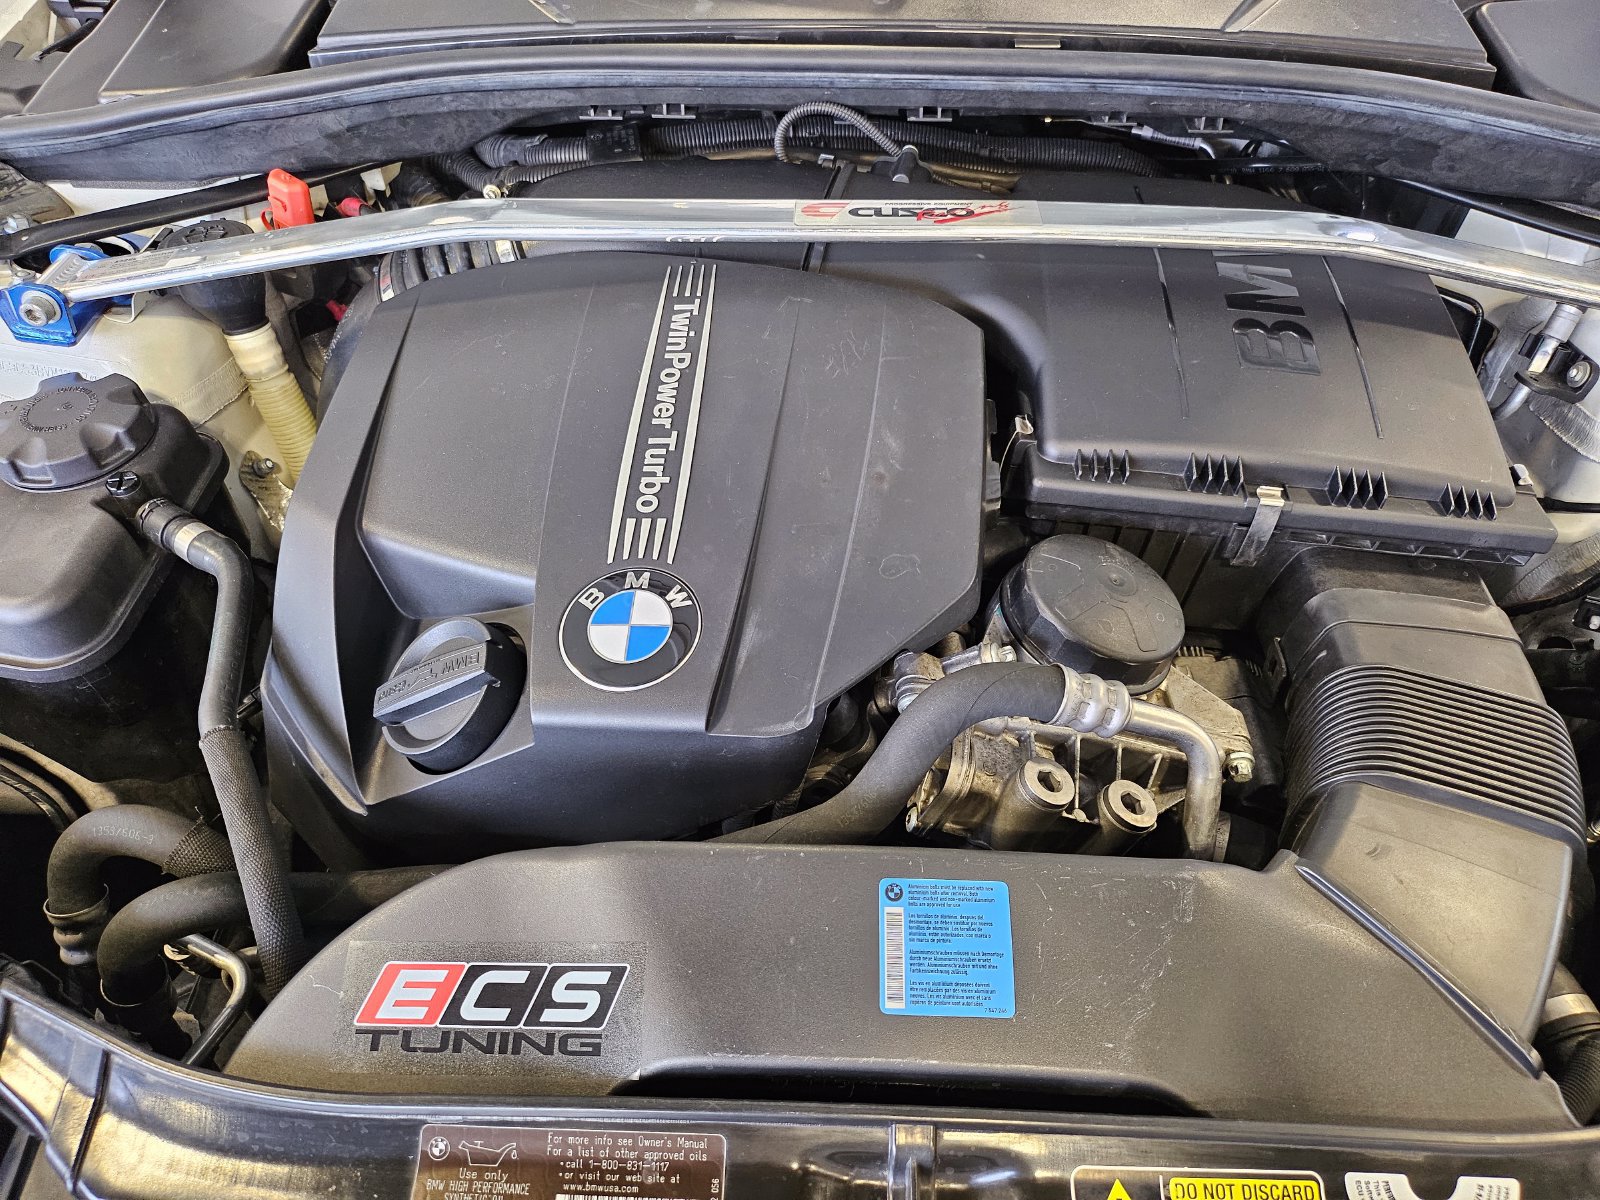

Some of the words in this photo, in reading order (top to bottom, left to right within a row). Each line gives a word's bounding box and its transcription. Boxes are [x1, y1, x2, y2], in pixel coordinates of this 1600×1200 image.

[1211, 251, 1320, 376] BM
[636, 431, 678, 514] Turbo
[578, 572, 693, 610] BMW
[375, 969, 612, 1022] ECS
[355, 1029, 602, 1056] TUNING
[547, 1132, 562, 1144] For
[568, 1135, 589, 1144] more
[595, 1134, 612, 1145] info
[618, 1137, 632, 1146] see
[639, 1136, 672, 1147] Owner's
[677, 1137, 708, 1149] Manual
[547, 1145, 562, 1156] For
[578, 1146, 594, 1157] list
[600, 1147, 609, 1158] of
[615, 1148, 638, 1159] other
[644, 1149, 684, 1161] approved
[689, 1150, 707, 1161] oils
[566, 1160, 583, 1168] call
[589, 1160, 669, 1172] 1-800-831-1117
[460, 1168, 477, 1179] Use
[485, 1170, 508, 1182] only
[579, 1171, 600, 1180] visit
[625, 1172, 642, 1182] web
[647, 1173, 664, 1183] site
[670, 1174, 680, 1183] at
[426, 1179, 445, 1190] BMW
[450, 1180, 469, 1192] HIGH
[473, 1181, 530, 1195] PERFORMANCE
[563, 1182, 639, 1193] www.bmwusa.com
[711, 1178, 720, 1193] 056
[1175, 1183, 1197, 1200] DO
[1203, 1184, 1234, 1200] NOT
[1242, 1185, 1315, 1200] DISCARD
[1355, 1180, 1364, 1196] ECU
